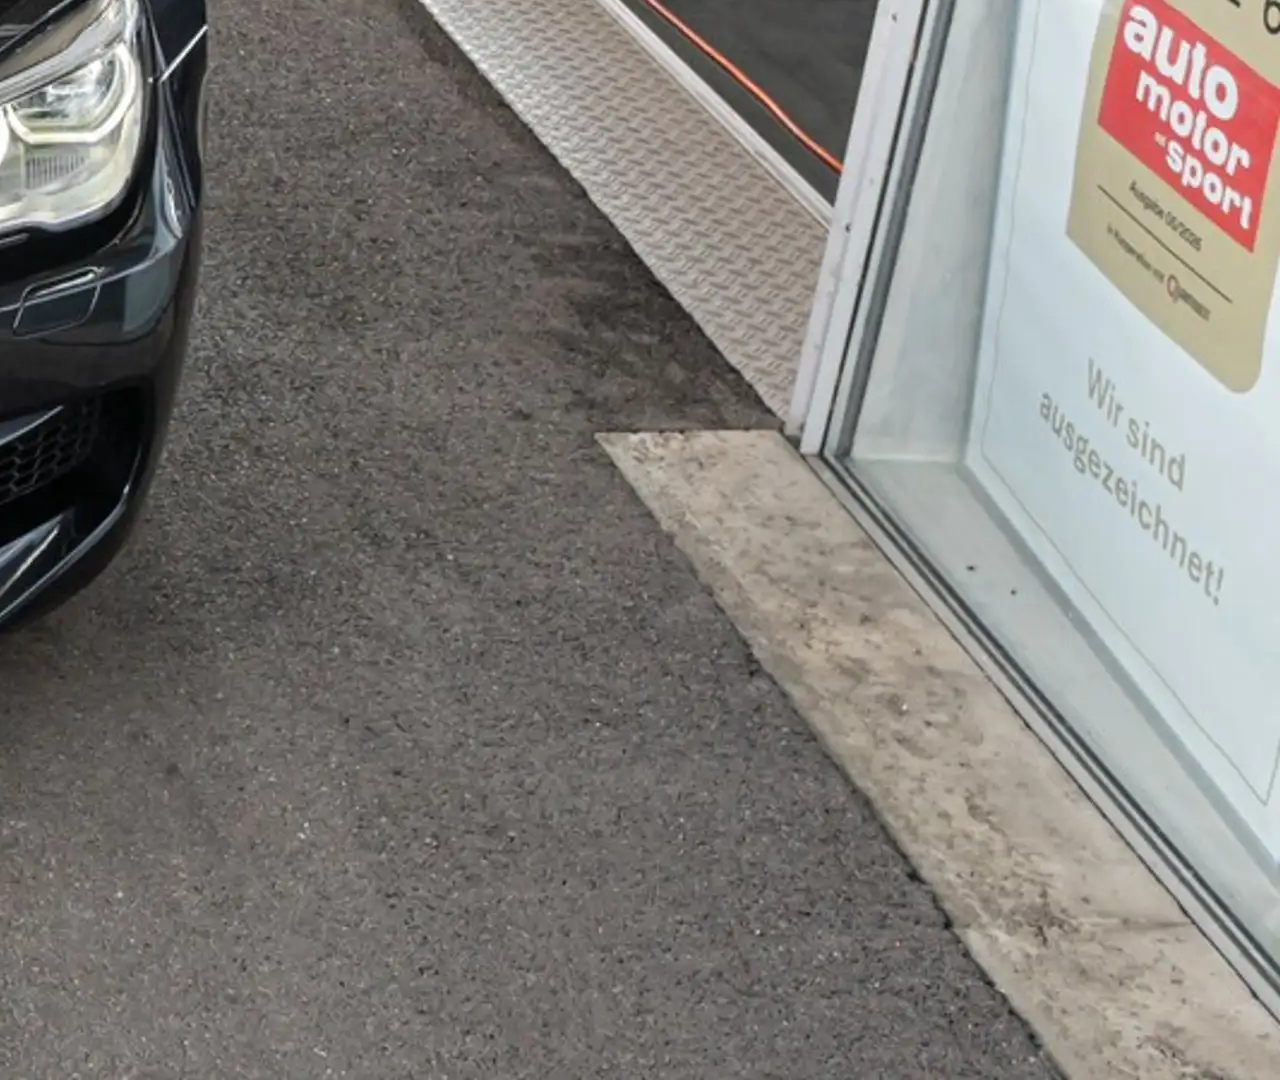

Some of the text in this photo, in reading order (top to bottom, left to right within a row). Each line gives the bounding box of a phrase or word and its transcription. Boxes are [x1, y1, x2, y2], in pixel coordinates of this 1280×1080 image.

[1123, 4, 1239, 121] auto
[1135, 69, 1251, 177] motor
[1165, 138, 1253, 230] sport
[1087, 356, 1187, 493] Wir sind
[1039, 392, 1225, 607] ausgezeichnet!
